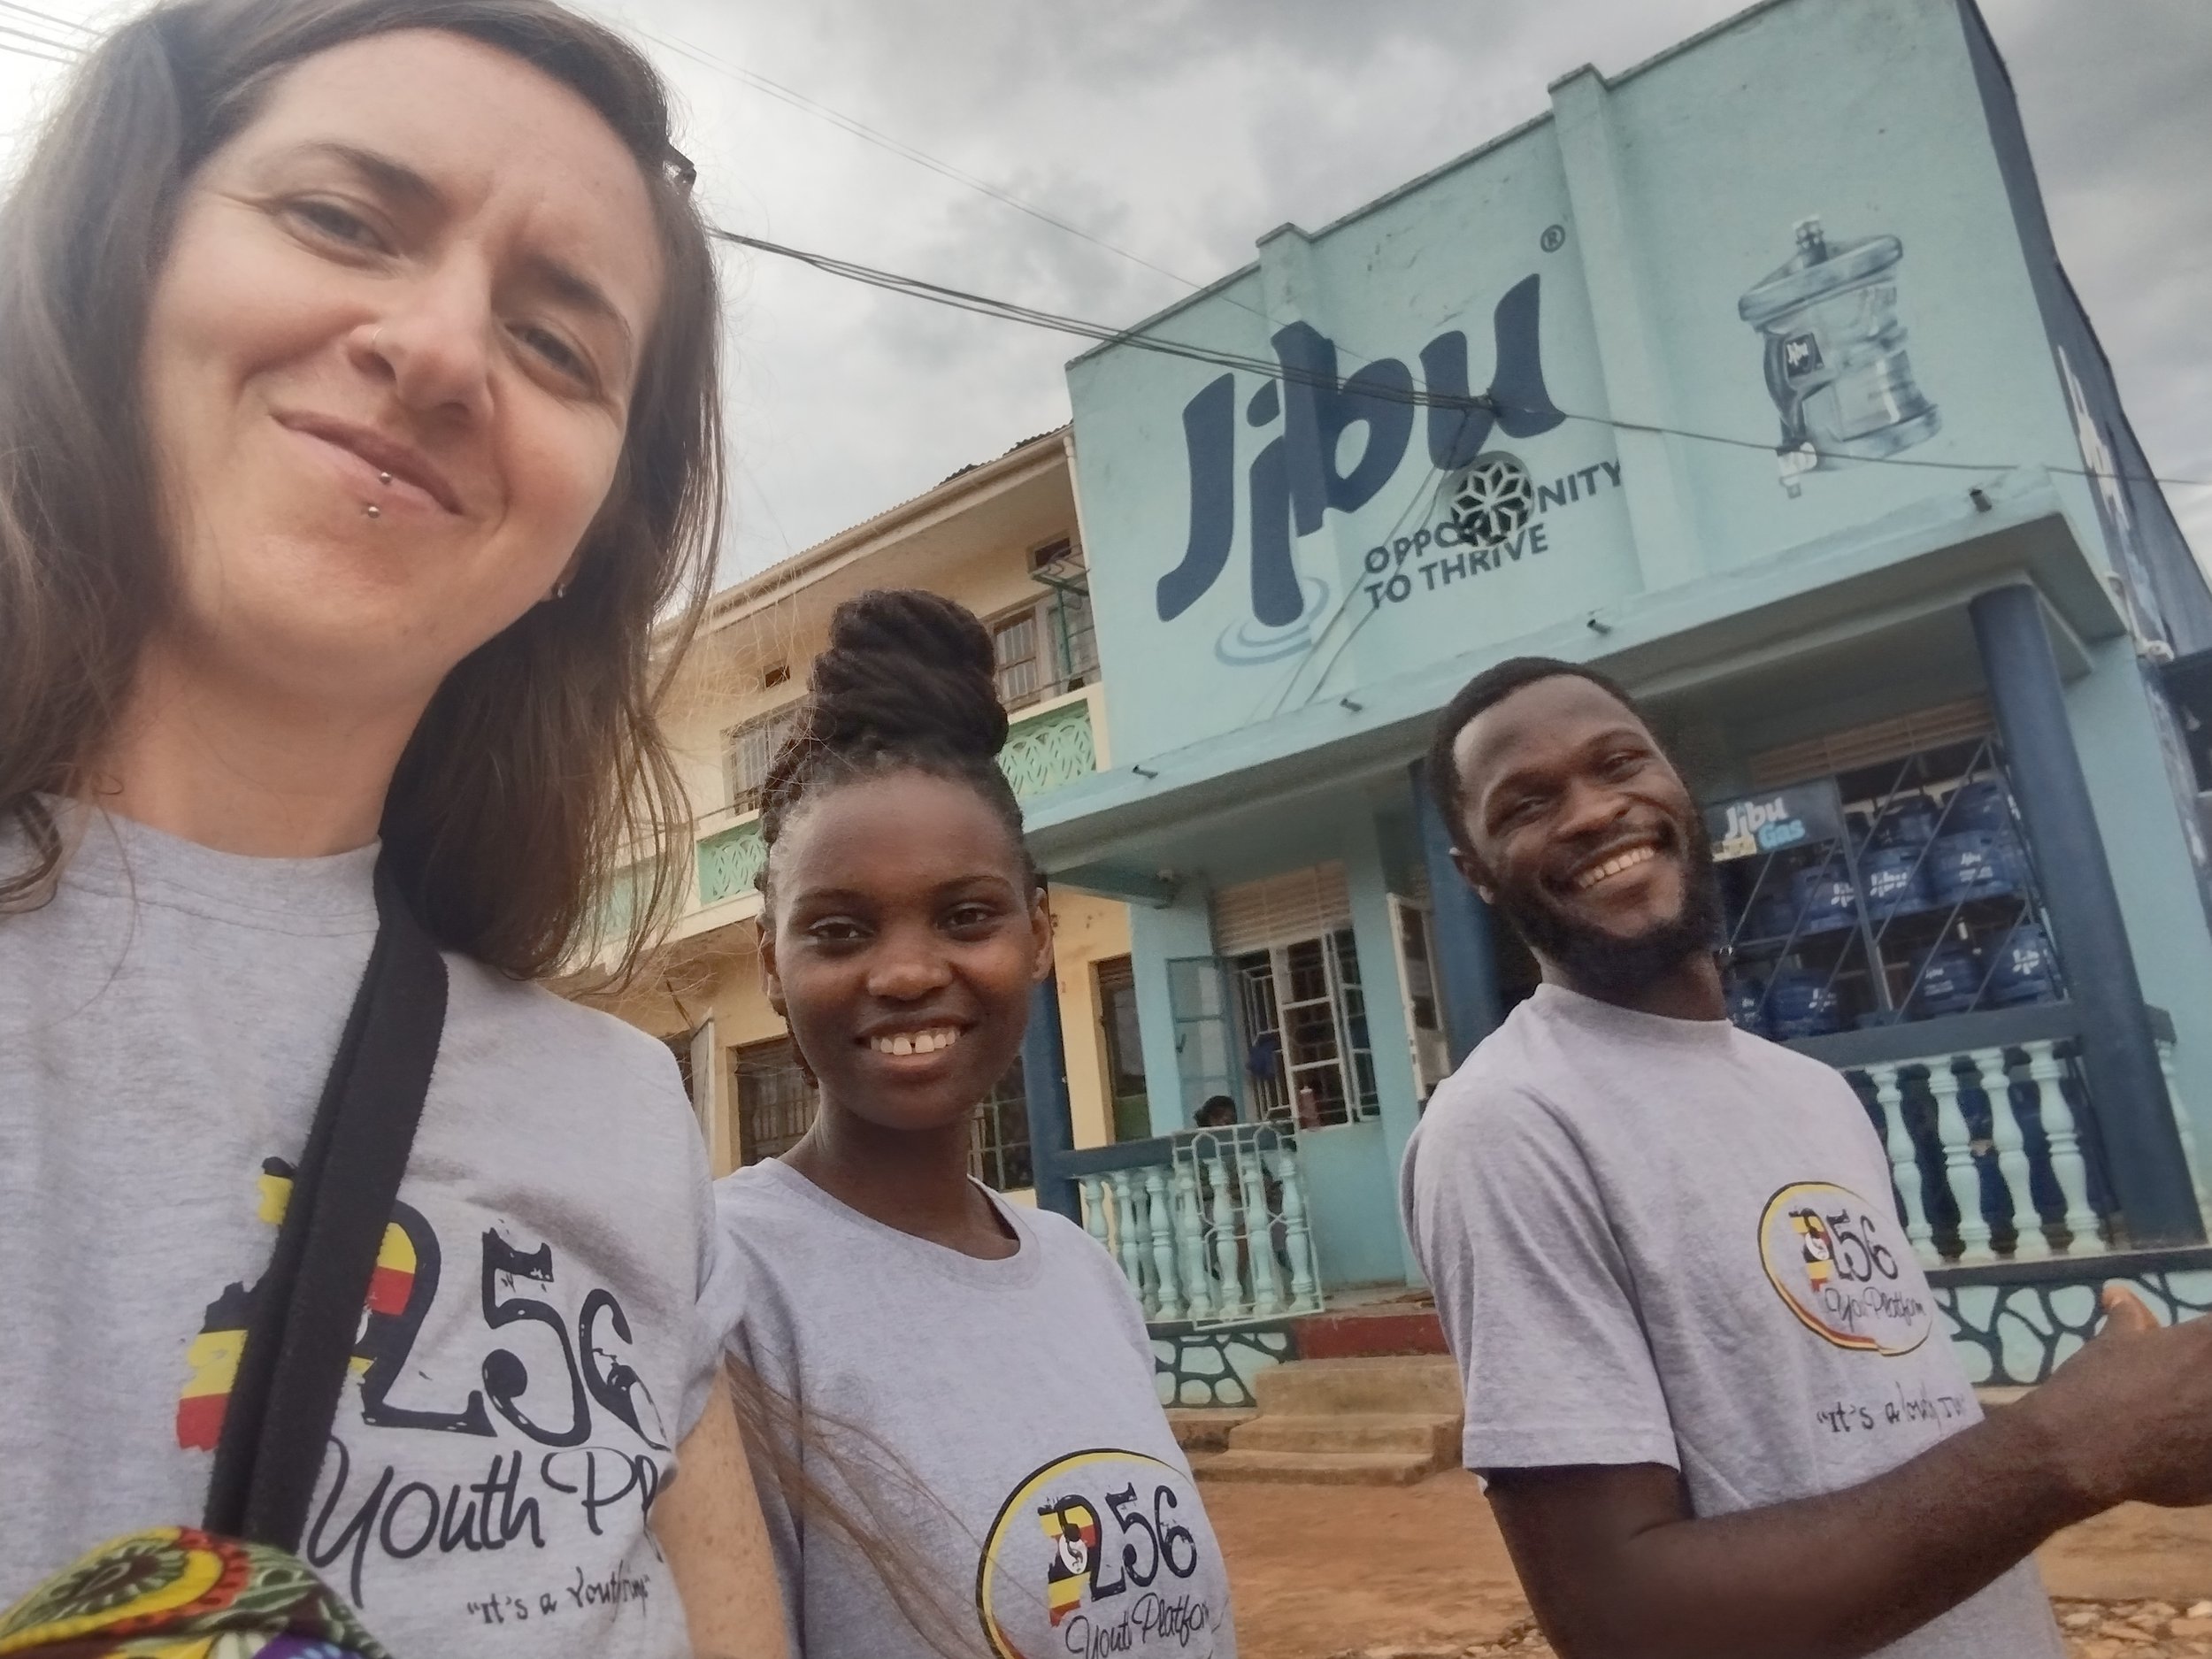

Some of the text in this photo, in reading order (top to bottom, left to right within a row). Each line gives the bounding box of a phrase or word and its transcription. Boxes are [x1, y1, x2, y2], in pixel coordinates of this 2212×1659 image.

[1156, 273, 1567, 627] Jibu
[1363, 522, 1549, 610] TO THRIVE
[1364, 458, 1622, 574] OPPONITY
[1724, 796, 1789, 840] Jibu
[1757, 818, 1806, 849] Gas
[1053, 1482, 1198, 1603] 256
